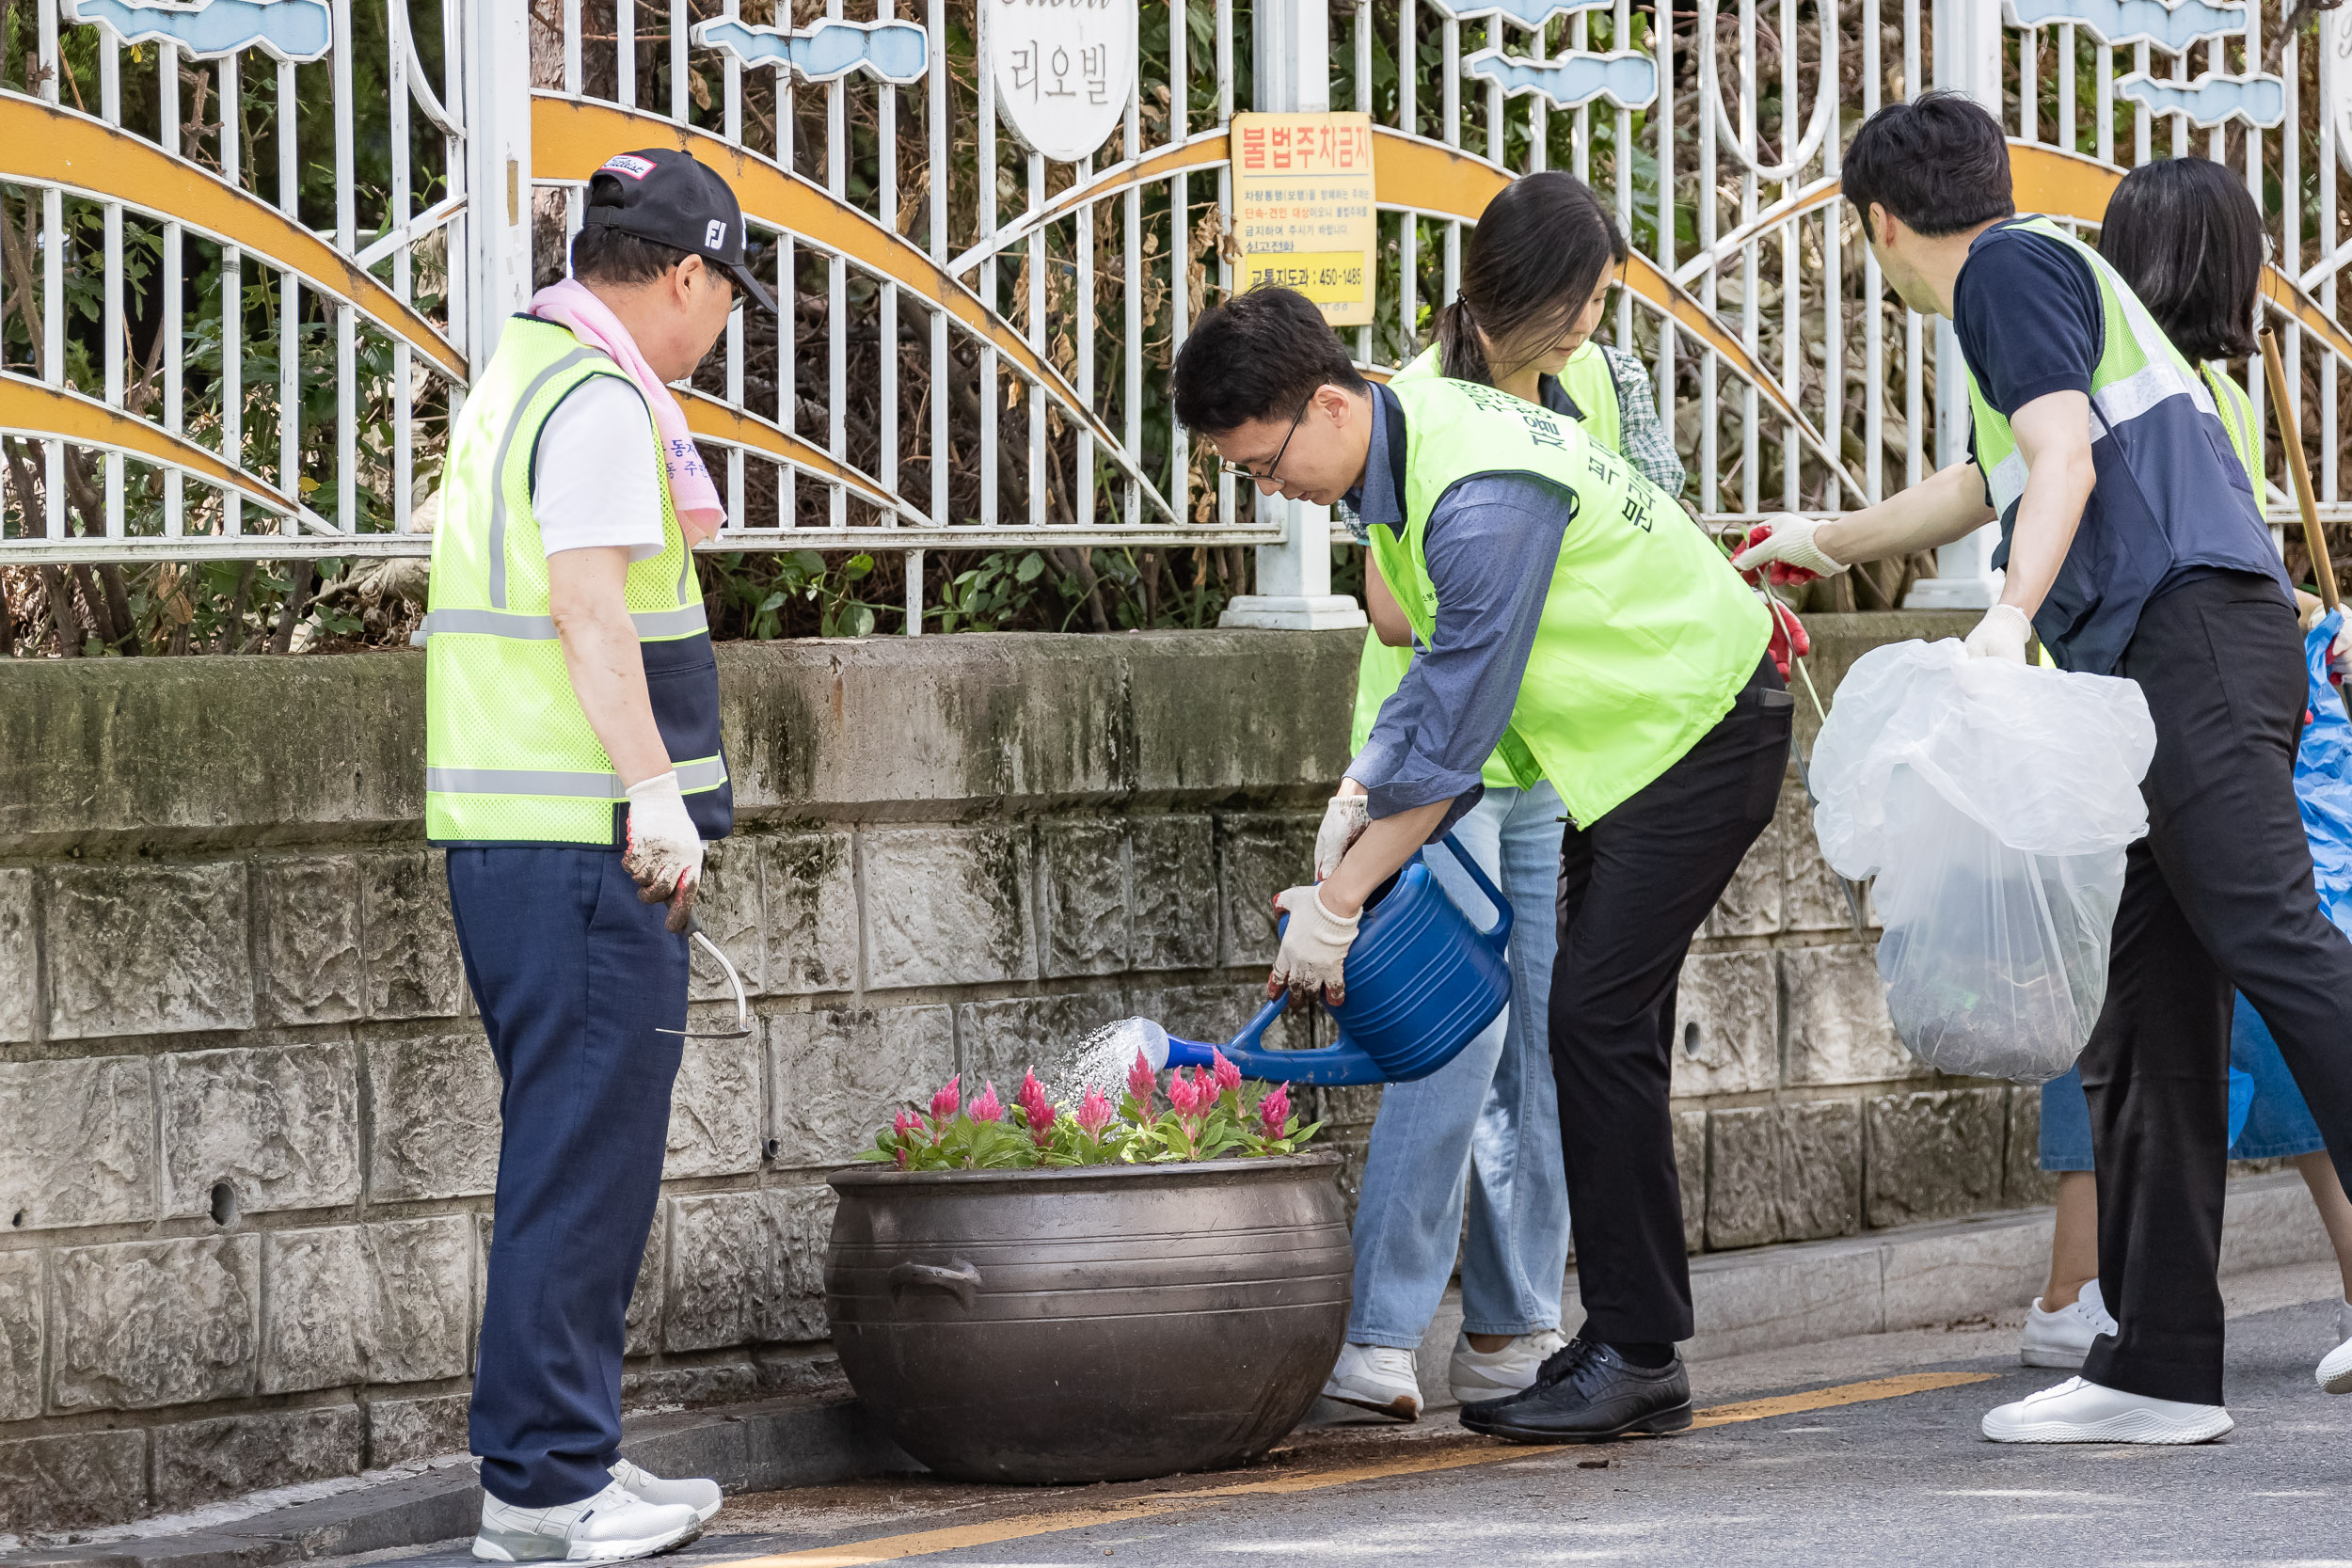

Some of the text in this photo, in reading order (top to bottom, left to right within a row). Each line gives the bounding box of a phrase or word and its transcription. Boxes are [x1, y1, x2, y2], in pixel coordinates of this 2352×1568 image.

[1010, 40, 1108, 104] 리오빌
[1243, 124, 1369, 169] 불법주차금지
[1245, 225, 1283, 237] 금지하여
[1289, 225, 1314, 236] 주시기
[1251, 267, 1309, 287] 교통지도과
